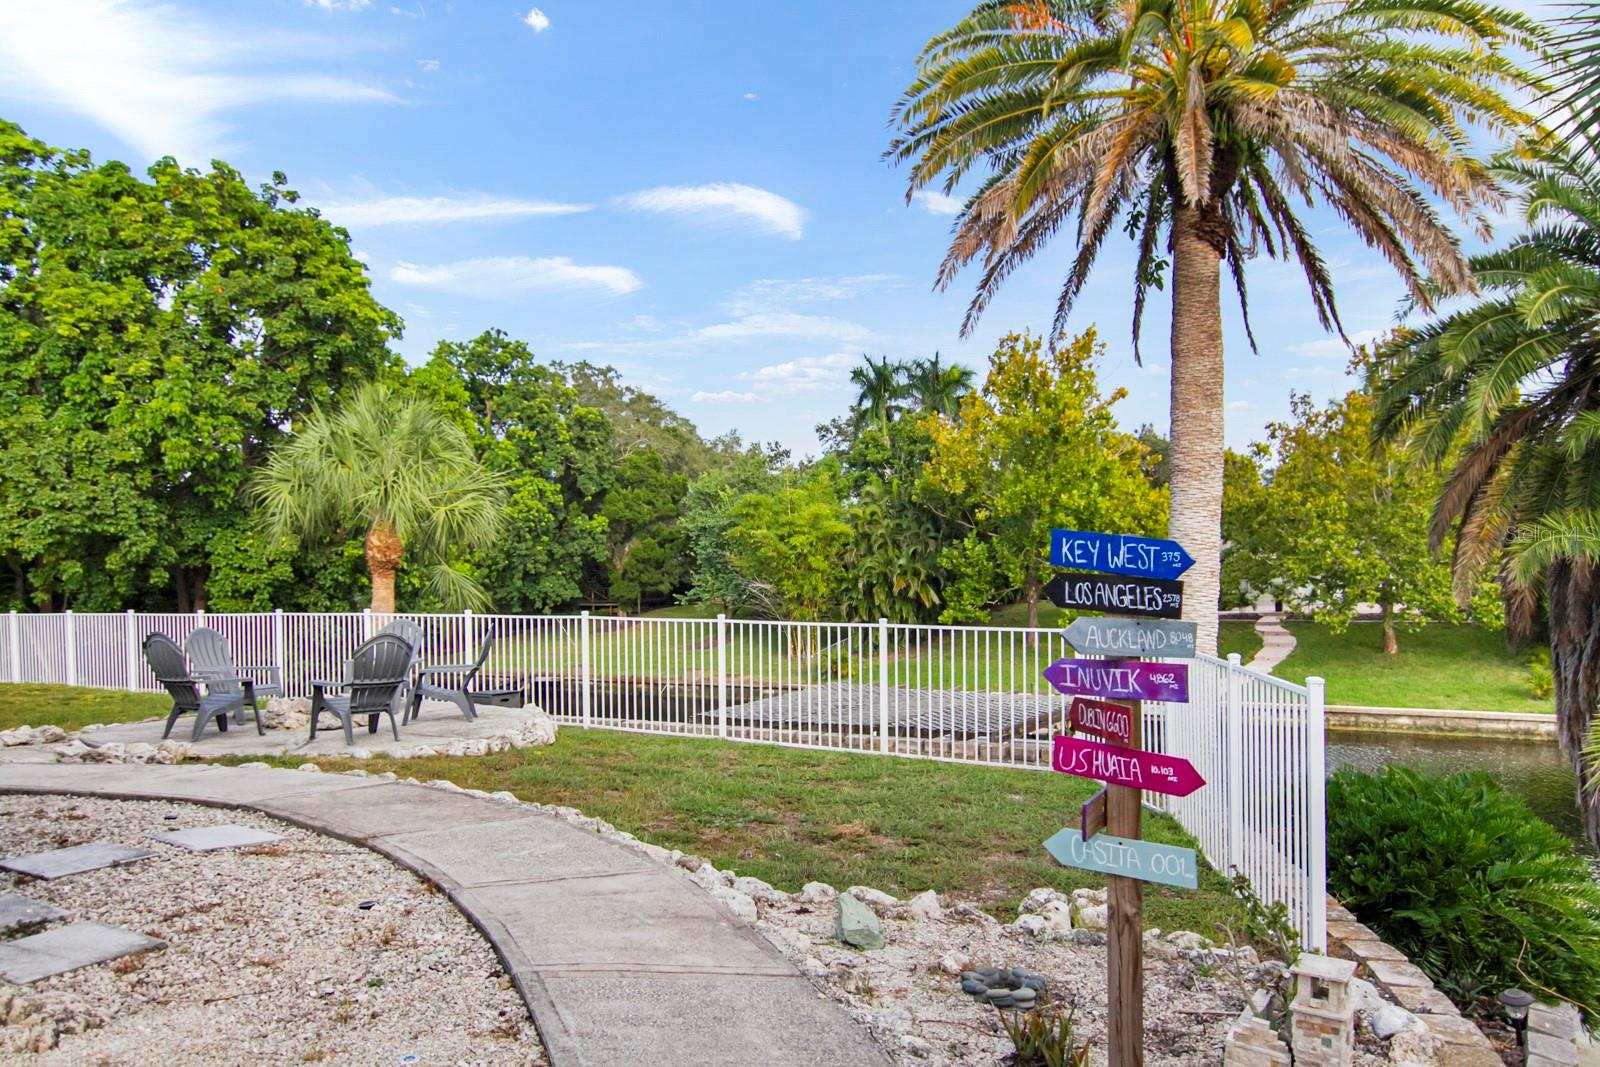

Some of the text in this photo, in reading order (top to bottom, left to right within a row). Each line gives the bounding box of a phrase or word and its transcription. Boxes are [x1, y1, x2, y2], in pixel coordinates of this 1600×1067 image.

[1062, 535, 1160, 572] KEY WEST
[1161, 552, 1180, 562] 375
[1065, 581, 1163, 611] LOS ANGELES
[1085, 625, 1166, 650] AUCKLAND
[1059, 664, 1143, 693] INUVIK
[1078, 703, 1129, 738] DUBLIN 6600
[1059, 745, 1143, 783] USHUAIA
[1071, 834, 1142, 870] CASITA
